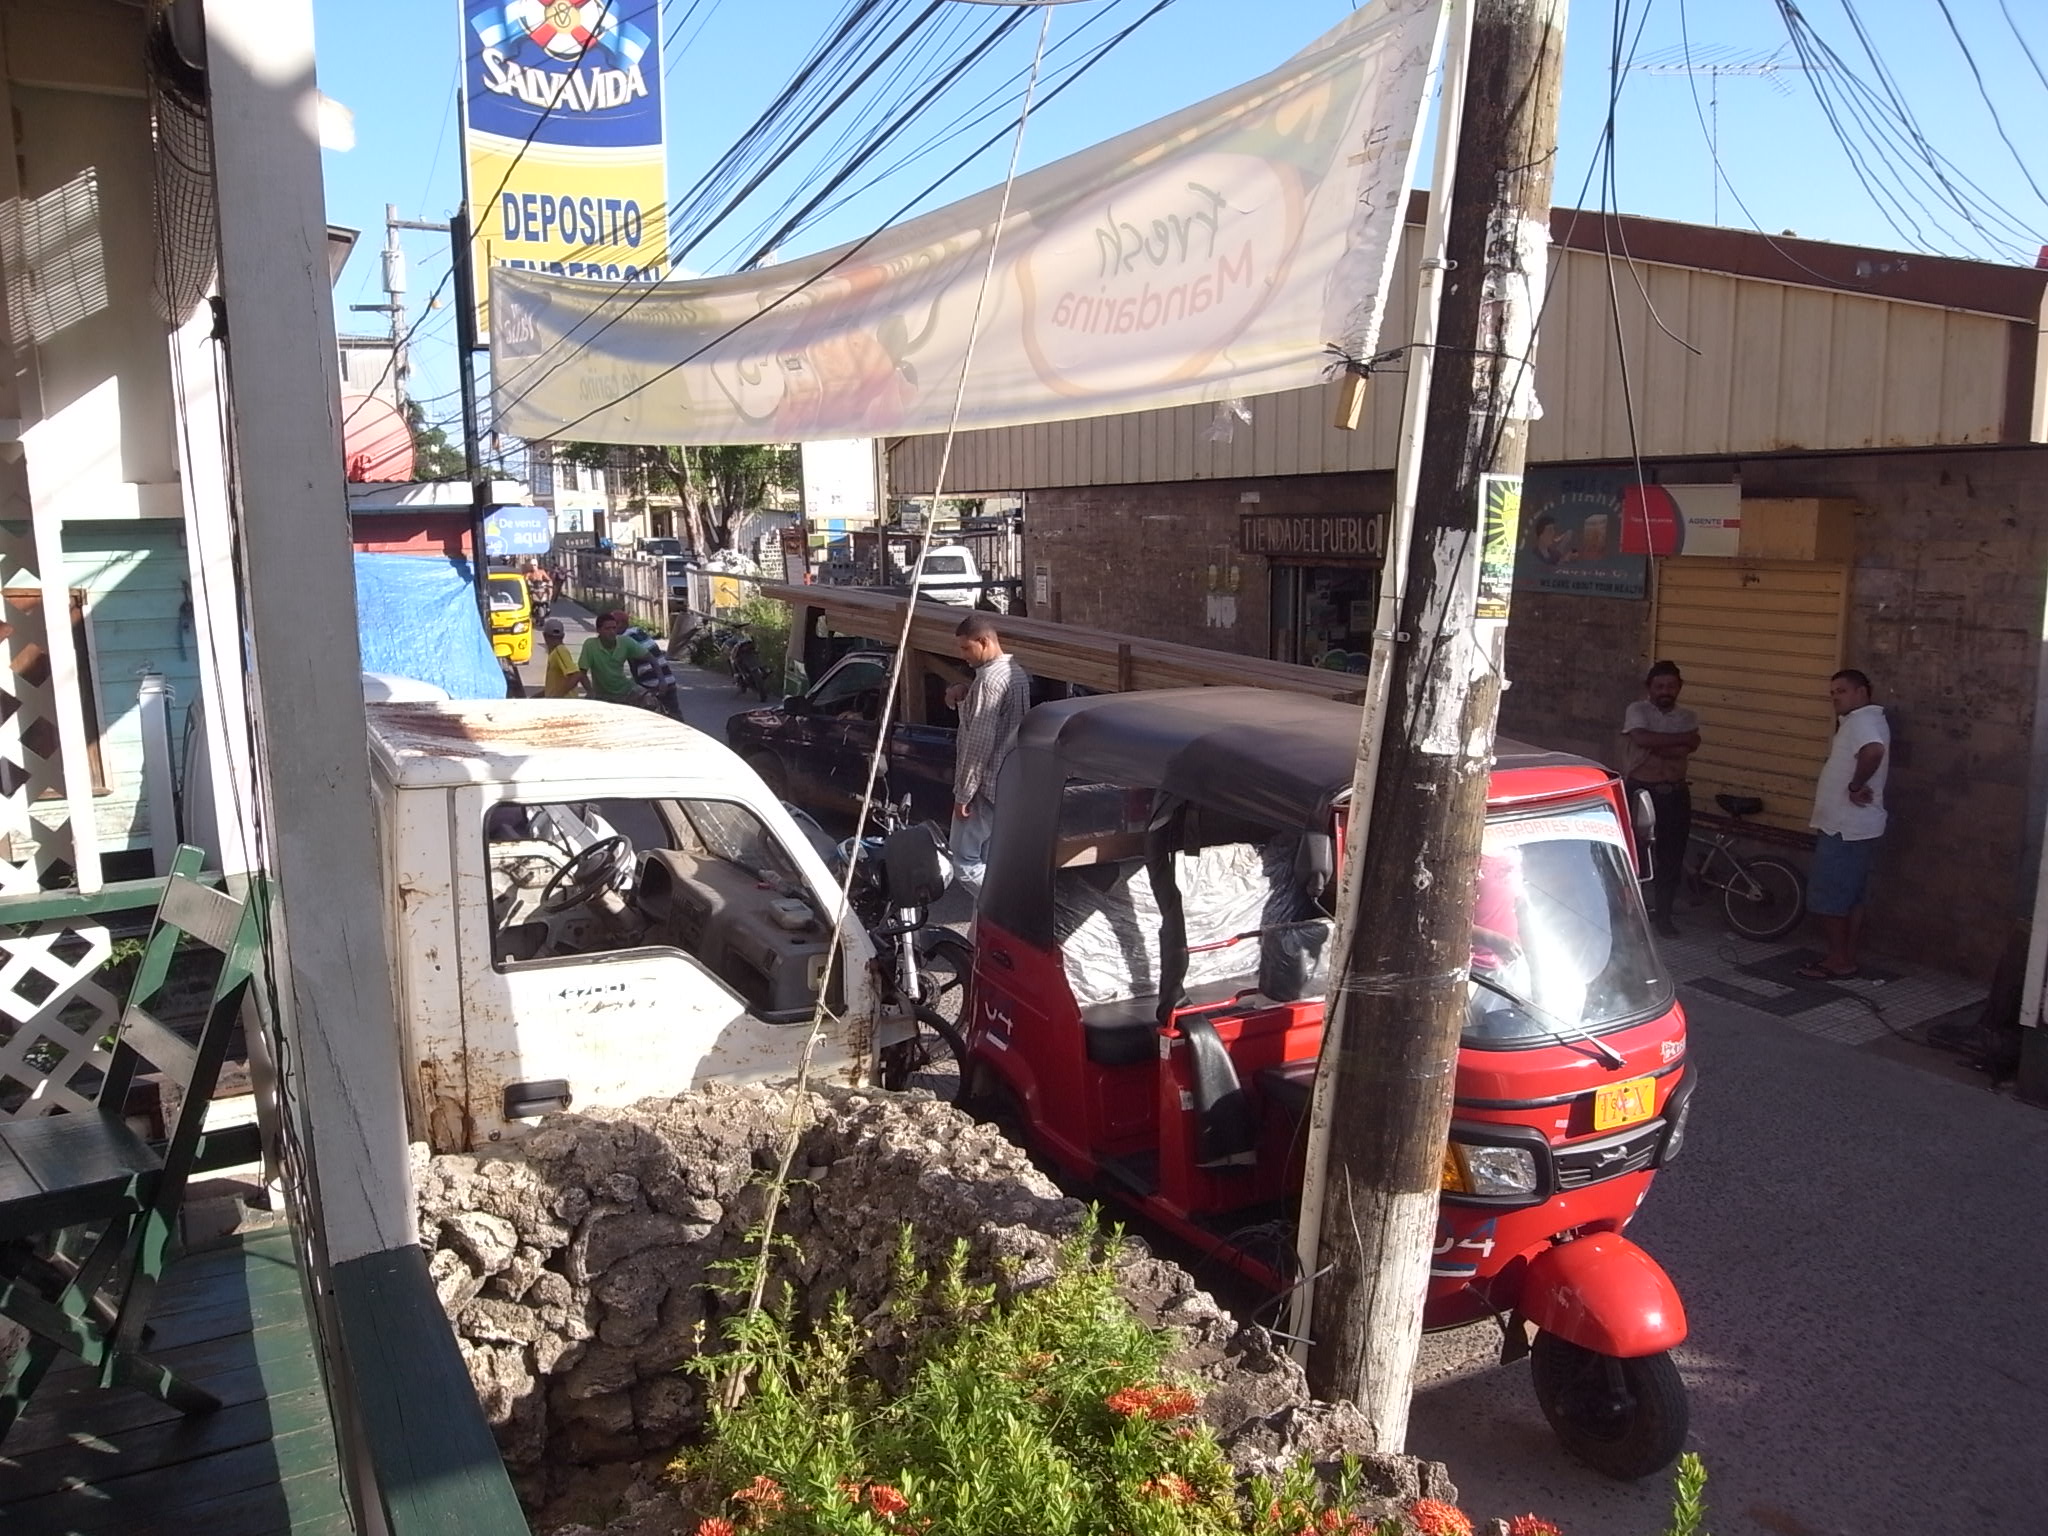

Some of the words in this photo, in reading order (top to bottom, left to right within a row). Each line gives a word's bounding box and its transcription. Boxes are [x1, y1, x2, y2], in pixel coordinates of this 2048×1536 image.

[481, 48, 649, 113] SALVAVIDA
[502, 192, 643, 248] DEPOSITO
[499, 518, 513, 528] De
[515, 519, 541, 528] venta
[1293, 518, 1319, 553] DEL
[1321, 518, 1377, 553] PUEBLO
[1688, 518, 1722, 526] AGENTE
[513, 528, 547, 548] aquí
